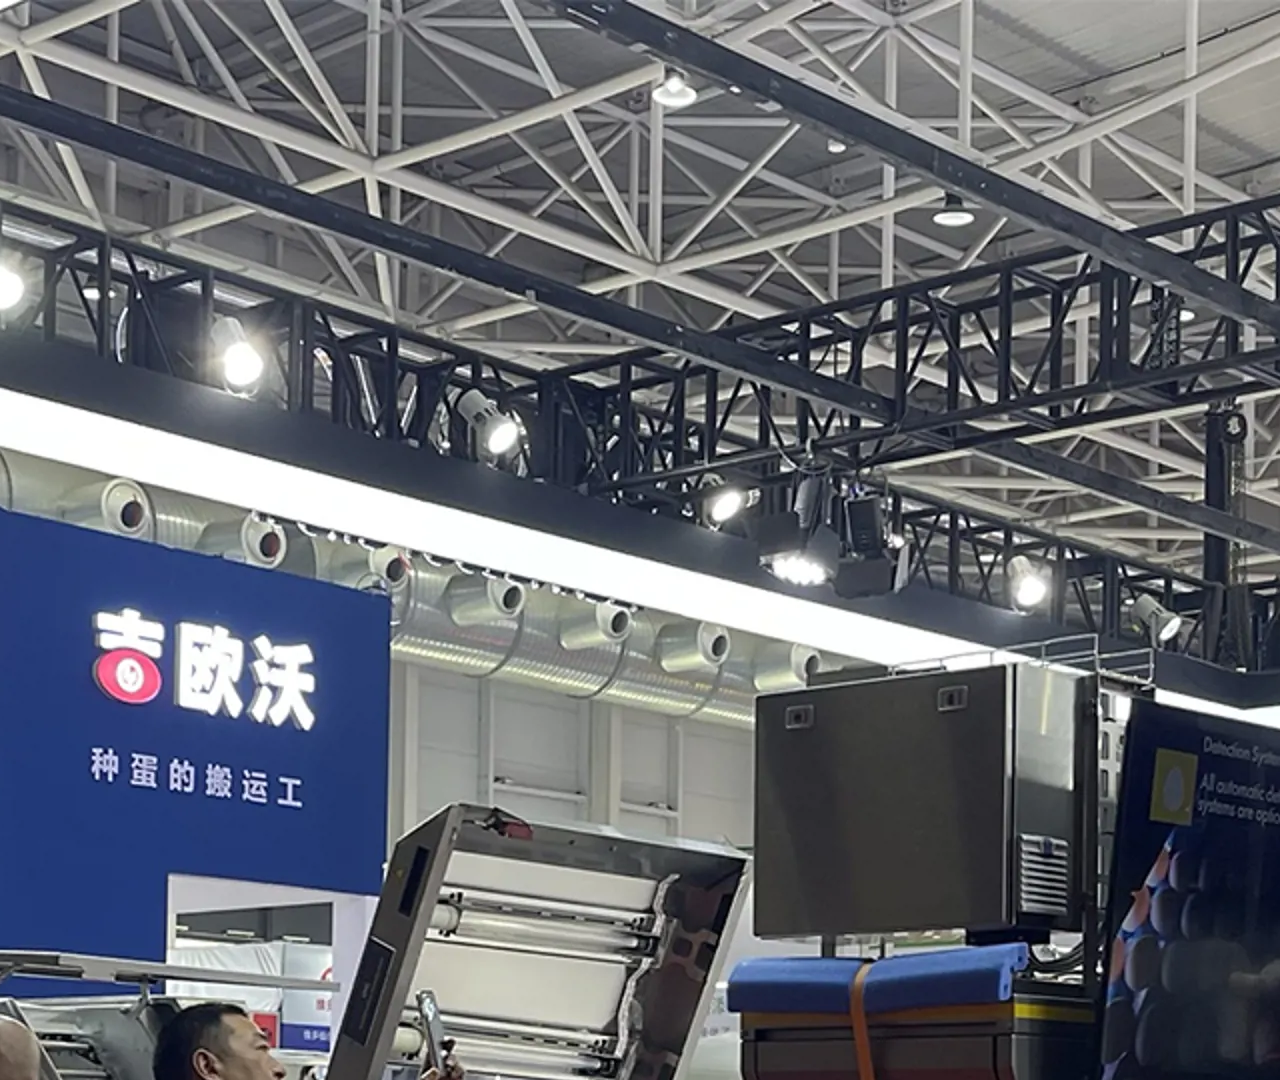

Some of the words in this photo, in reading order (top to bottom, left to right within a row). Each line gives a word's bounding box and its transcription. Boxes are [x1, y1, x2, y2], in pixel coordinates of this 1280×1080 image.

[1204, 736, 1251, 760] Detection
[91, 747, 304, 809] 种蛋的搬运工
[1200, 773, 1216, 791] All
[1216, 780, 1265, 801] automatic
[1198, 799, 1235, 817] systems
[1238, 806, 1254, 820] are
